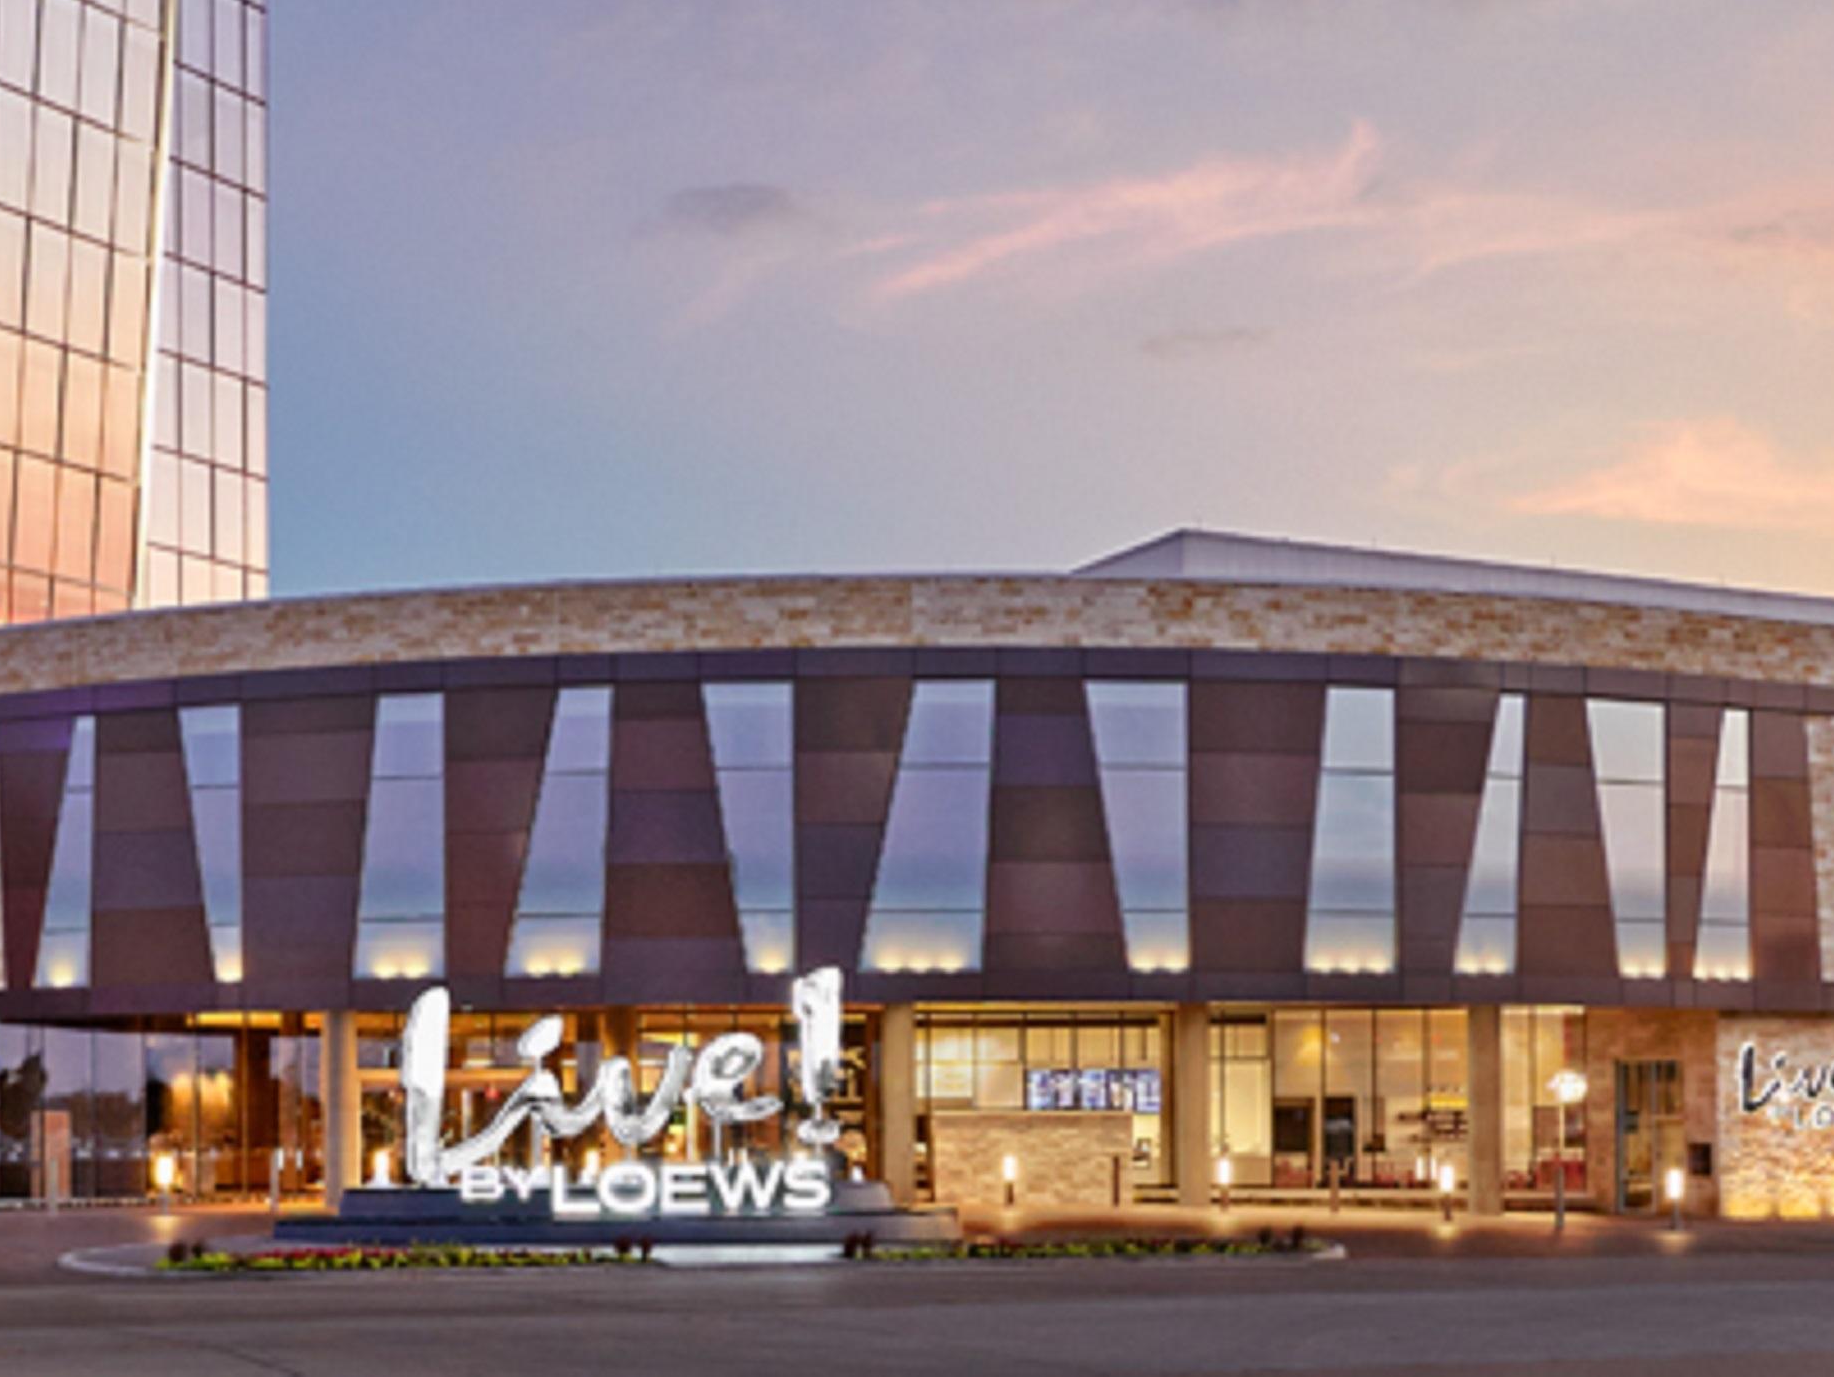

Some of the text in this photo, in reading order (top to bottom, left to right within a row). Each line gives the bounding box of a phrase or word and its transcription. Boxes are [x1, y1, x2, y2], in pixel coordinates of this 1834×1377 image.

[401, 966, 843, 1185] Live!
[460, 1159, 831, 1215] BY LOEWS
